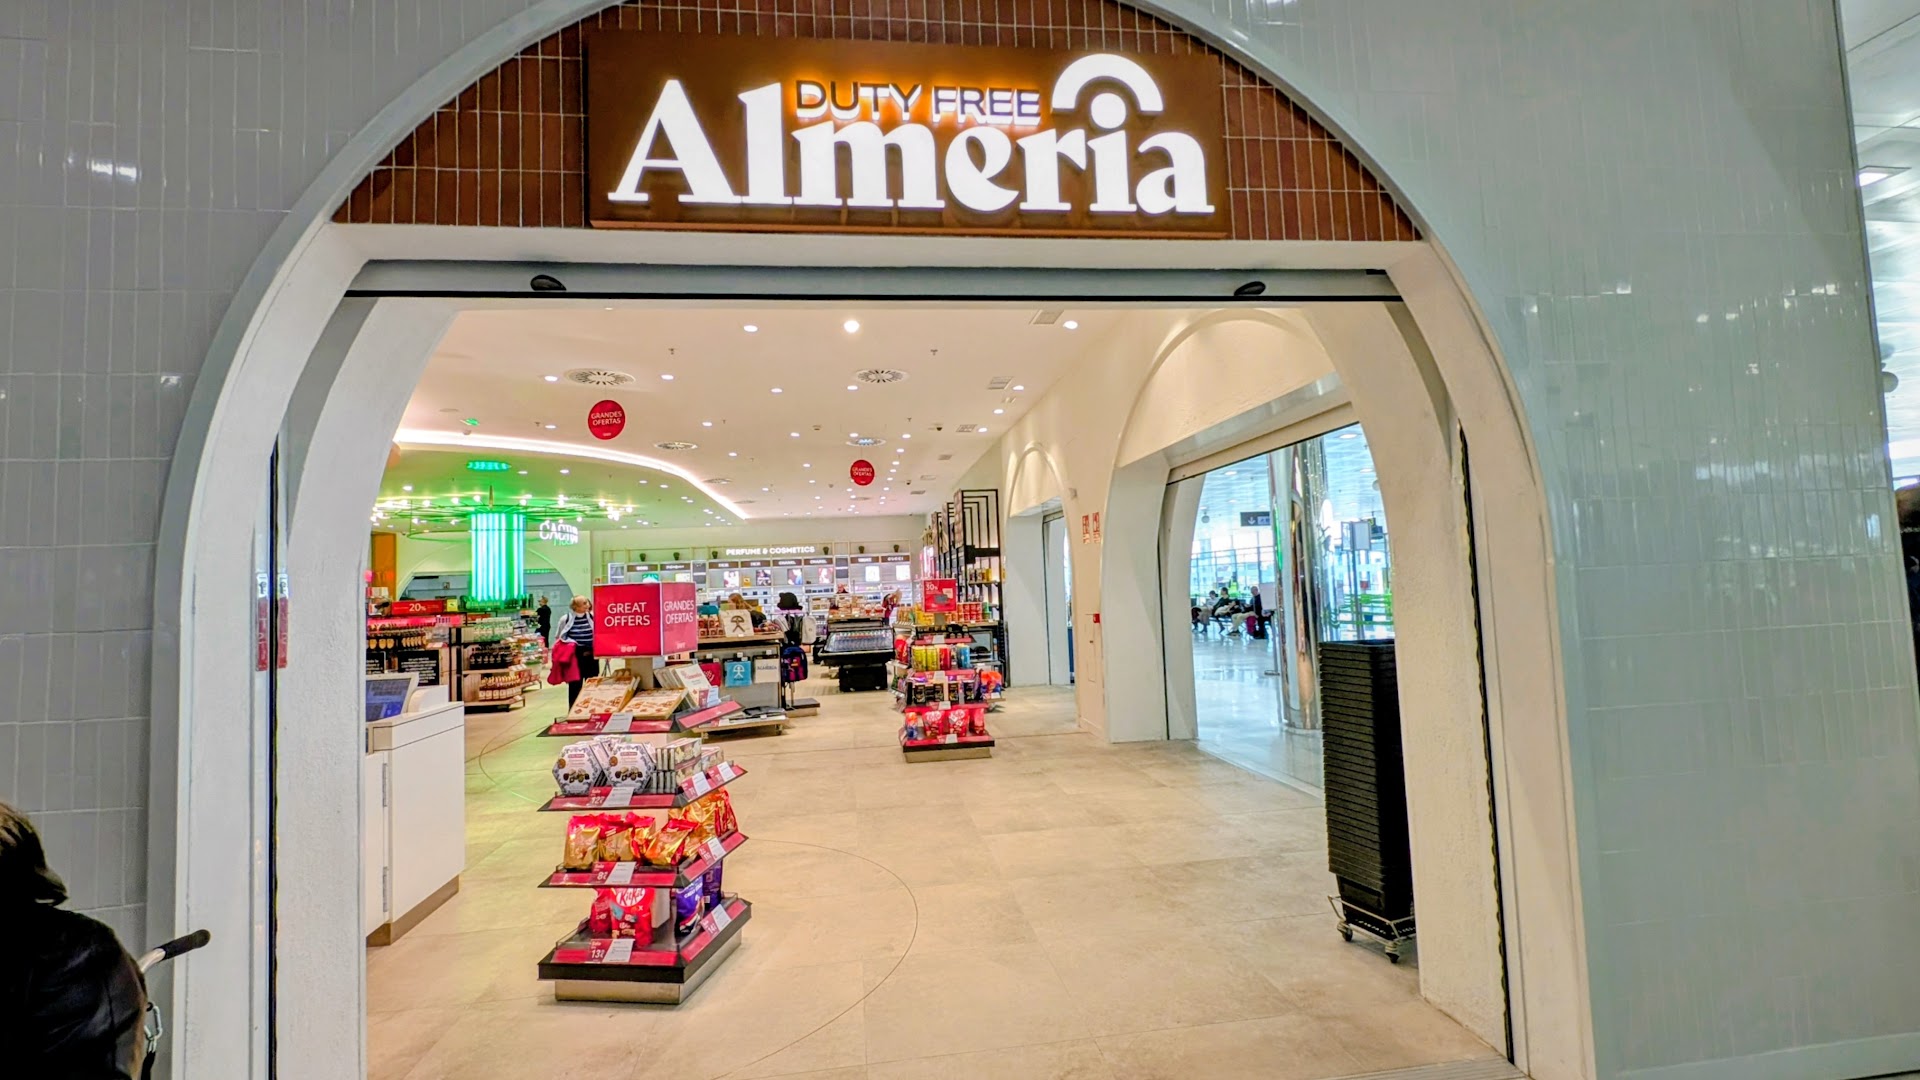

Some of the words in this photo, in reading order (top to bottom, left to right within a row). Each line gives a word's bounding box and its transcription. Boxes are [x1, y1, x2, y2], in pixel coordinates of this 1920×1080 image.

[796, 79, 922, 121] DUTY
[932, 86, 1042, 126] FREE
[591, 411, 622, 420] GRANDES
[592, 417, 622, 426] OFERTAS
[725, 548, 762, 556] PERFUME
[762, 547, 769, 555] &
[769, 546, 816, 555] COSMETICS
[409, 603, 427, 612] 20%
[607, 602, 647, 614] GREAT
[663, 599, 695, 612] GRANDES
[604, 614, 651, 628] OFFERS
[665, 611, 694, 625] OFERTAS
